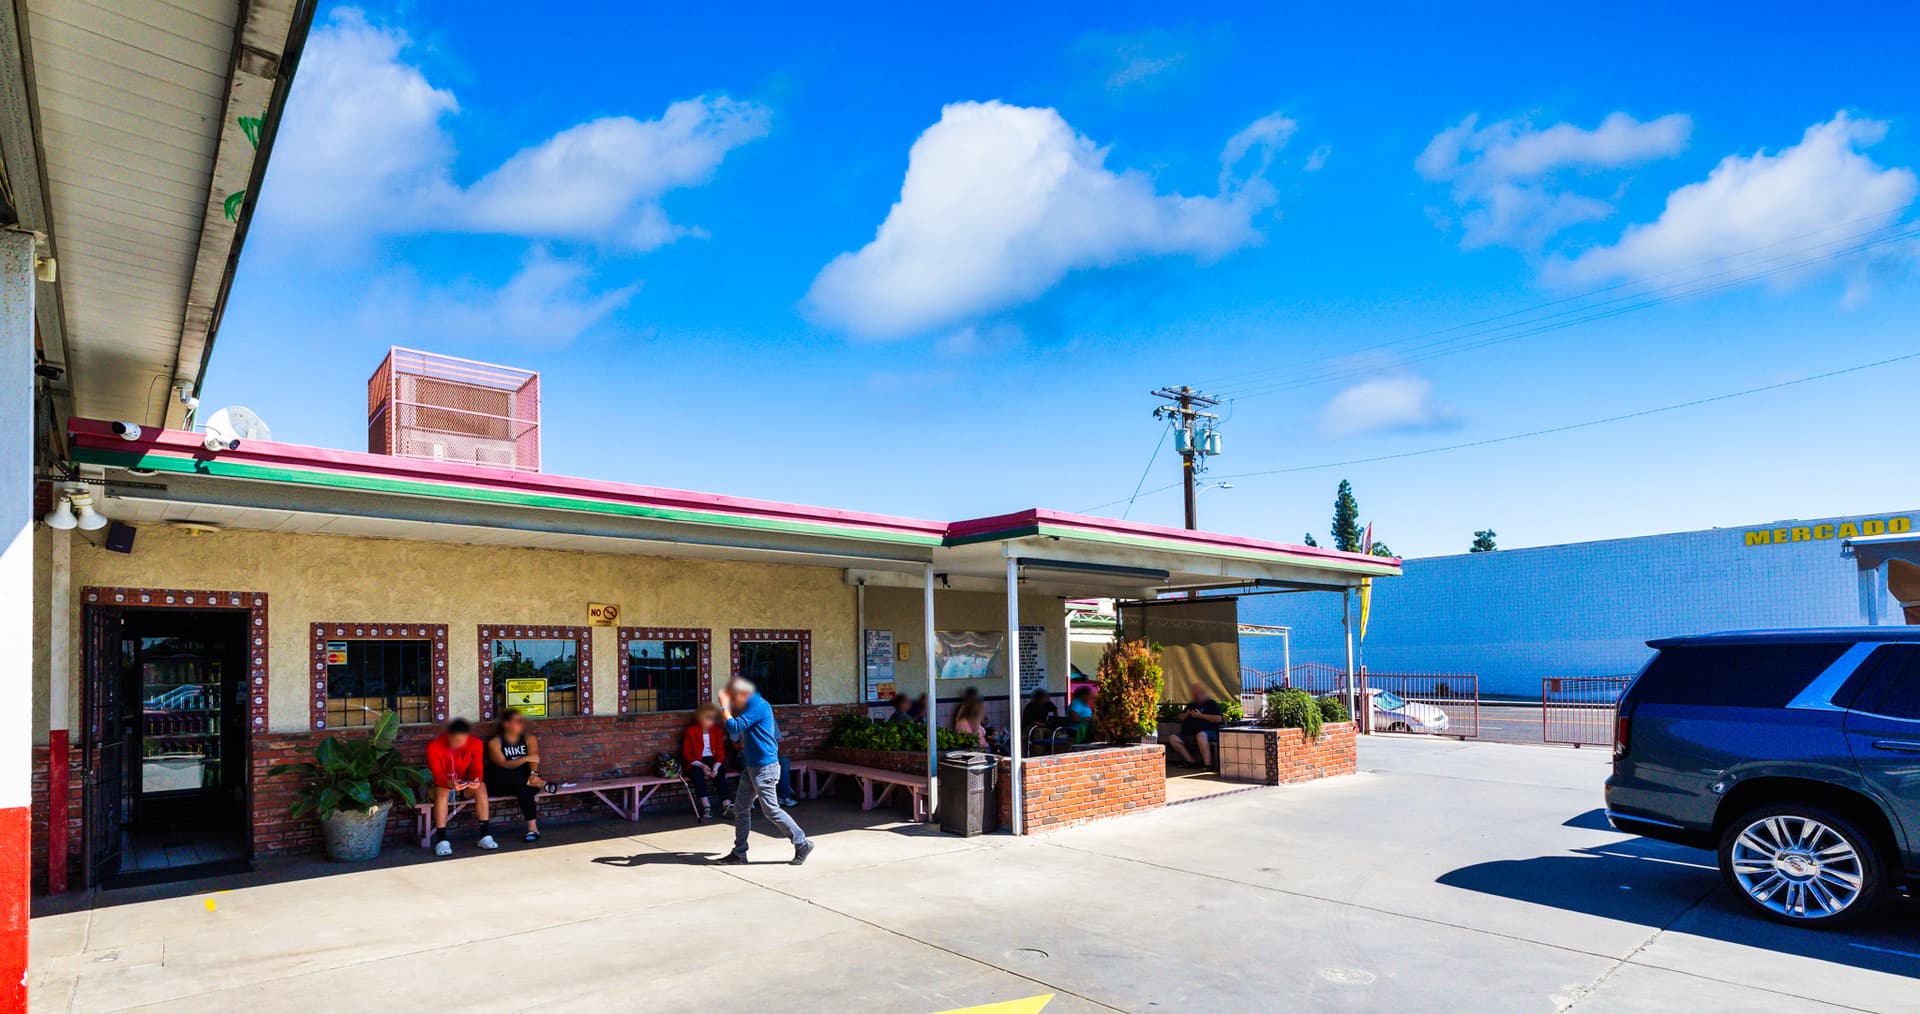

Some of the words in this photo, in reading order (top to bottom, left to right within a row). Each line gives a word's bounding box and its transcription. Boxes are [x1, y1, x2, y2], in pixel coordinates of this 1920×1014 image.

[1745, 517, 1911, 546] MERCADO
[591, 609, 601, 617] NO
[504, 745, 526, 757] NIKE
